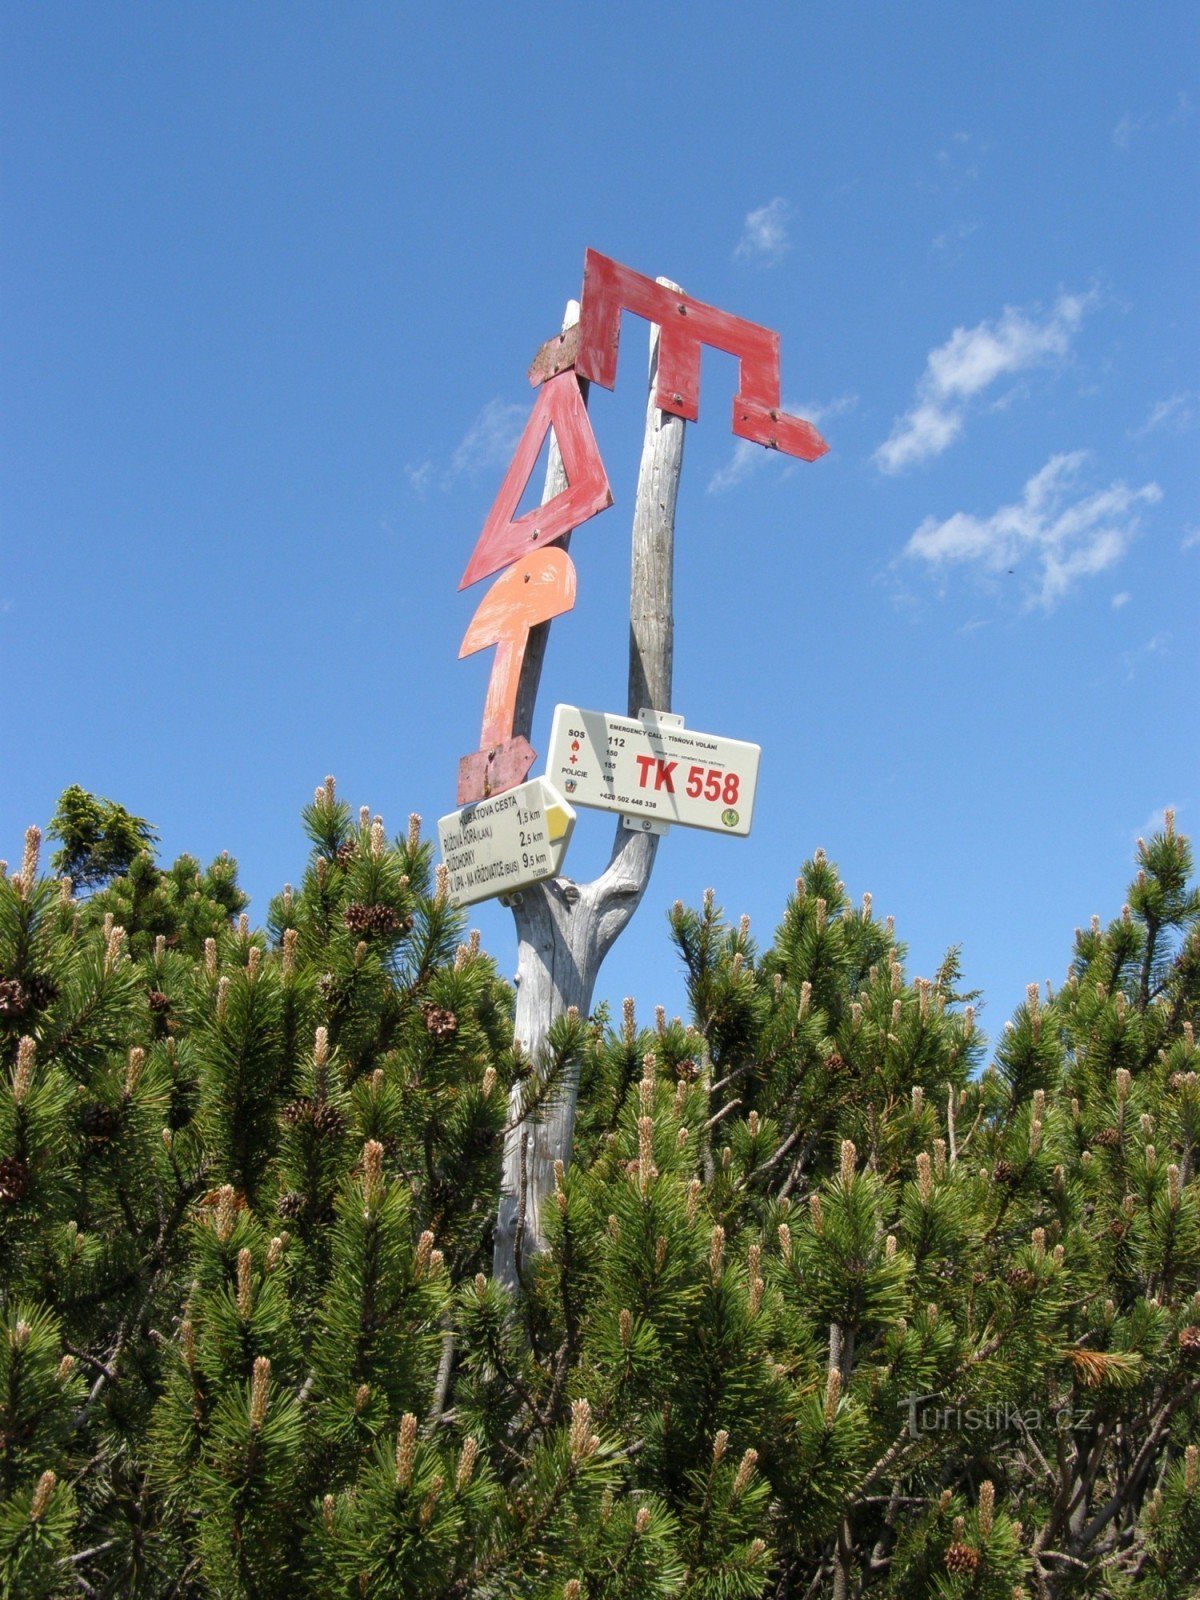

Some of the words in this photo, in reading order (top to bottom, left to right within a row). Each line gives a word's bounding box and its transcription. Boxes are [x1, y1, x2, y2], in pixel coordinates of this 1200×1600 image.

[568, 728, 586, 740] SOS
[609, 723, 647, 737] EMERGENCY
[647, 730, 663, 741] CALL
[608, 736, 626, 748] 112
[606, 749, 618, 758] 150
[561, 766, 588, 779] POLICIE
[604, 761, 616, 770] 155
[636, 754, 679, 794] TK
[685, 765, 740, 806] 558
[495, 795, 518, 812] CESTA
[599, 792, 616, 801] +420
[516, 809, 529, 826] 1,5
[529, 810, 541, 821] km
[519, 831, 532, 848] 2,5
[532, 831, 544, 842] km
[522, 852, 535, 869] 9,5
[535, 853, 547, 864] km
